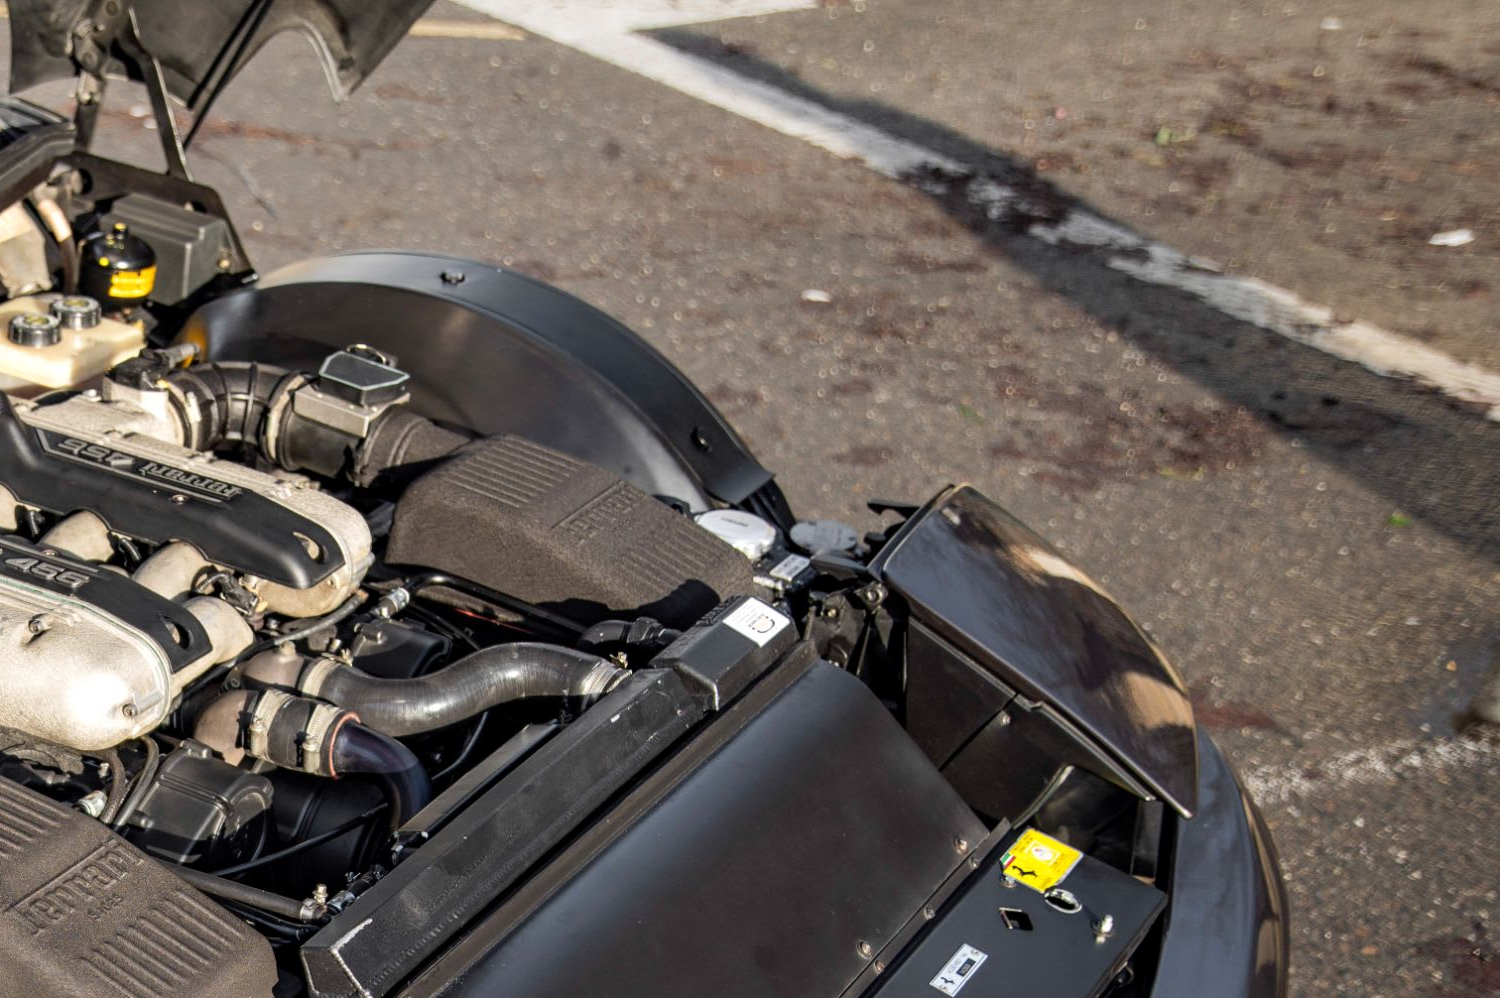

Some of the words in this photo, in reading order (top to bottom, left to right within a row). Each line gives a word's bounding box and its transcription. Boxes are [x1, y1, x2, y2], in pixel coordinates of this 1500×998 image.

[58, 438, 134, 467] 456
[139, 462, 243, 500] Ferrari
[4, 556, 90, 588] 456
[3, 836, 144, 937] Ferrari
